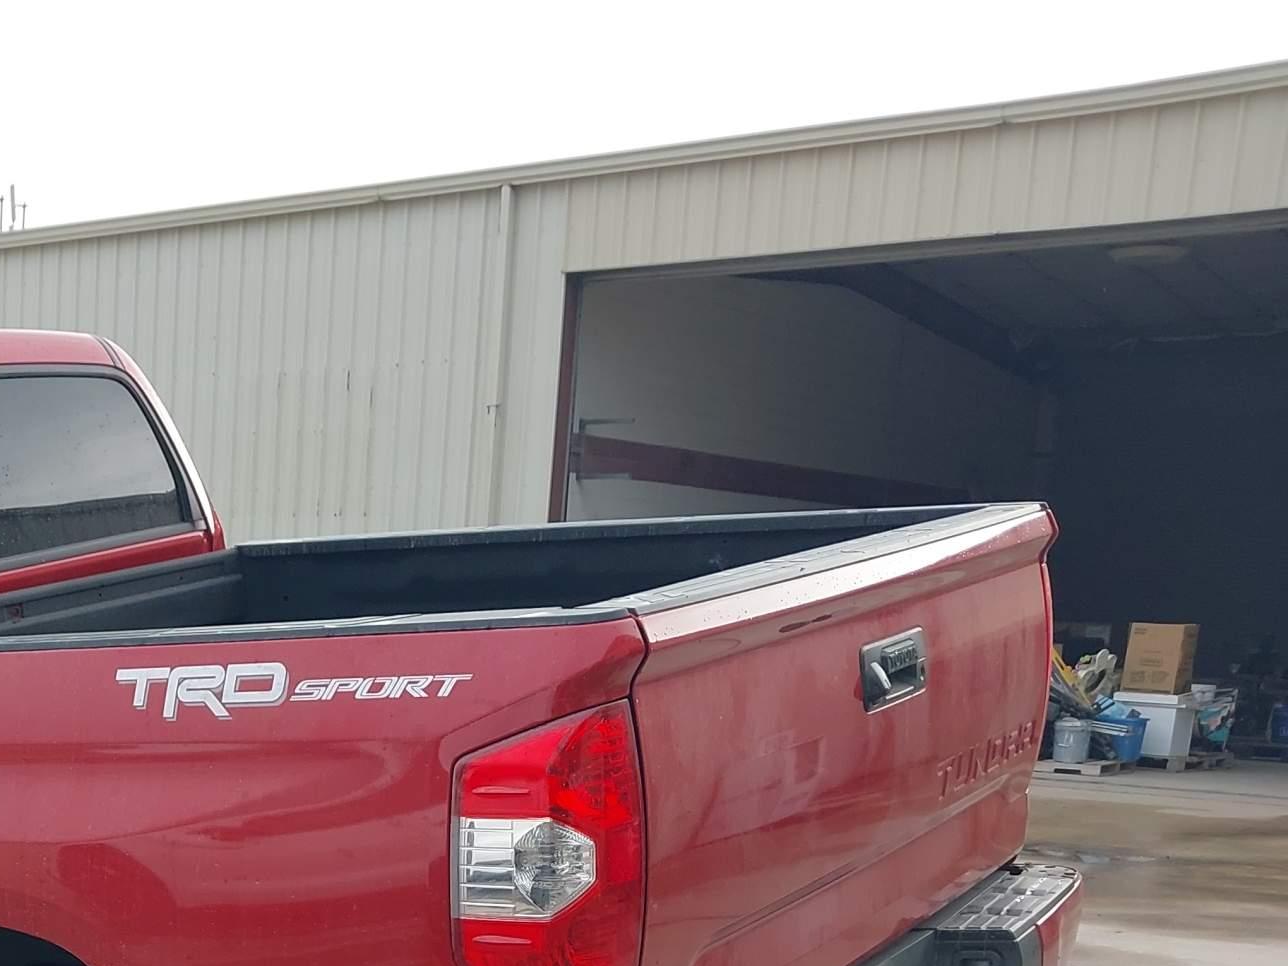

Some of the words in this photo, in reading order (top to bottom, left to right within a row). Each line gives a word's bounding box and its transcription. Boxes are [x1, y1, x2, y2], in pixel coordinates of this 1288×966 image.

[115, 662, 289, 721] TRD
[290, 674, 473, 701] SPORT
[937, 720, 1037, 800] TUNDRA
